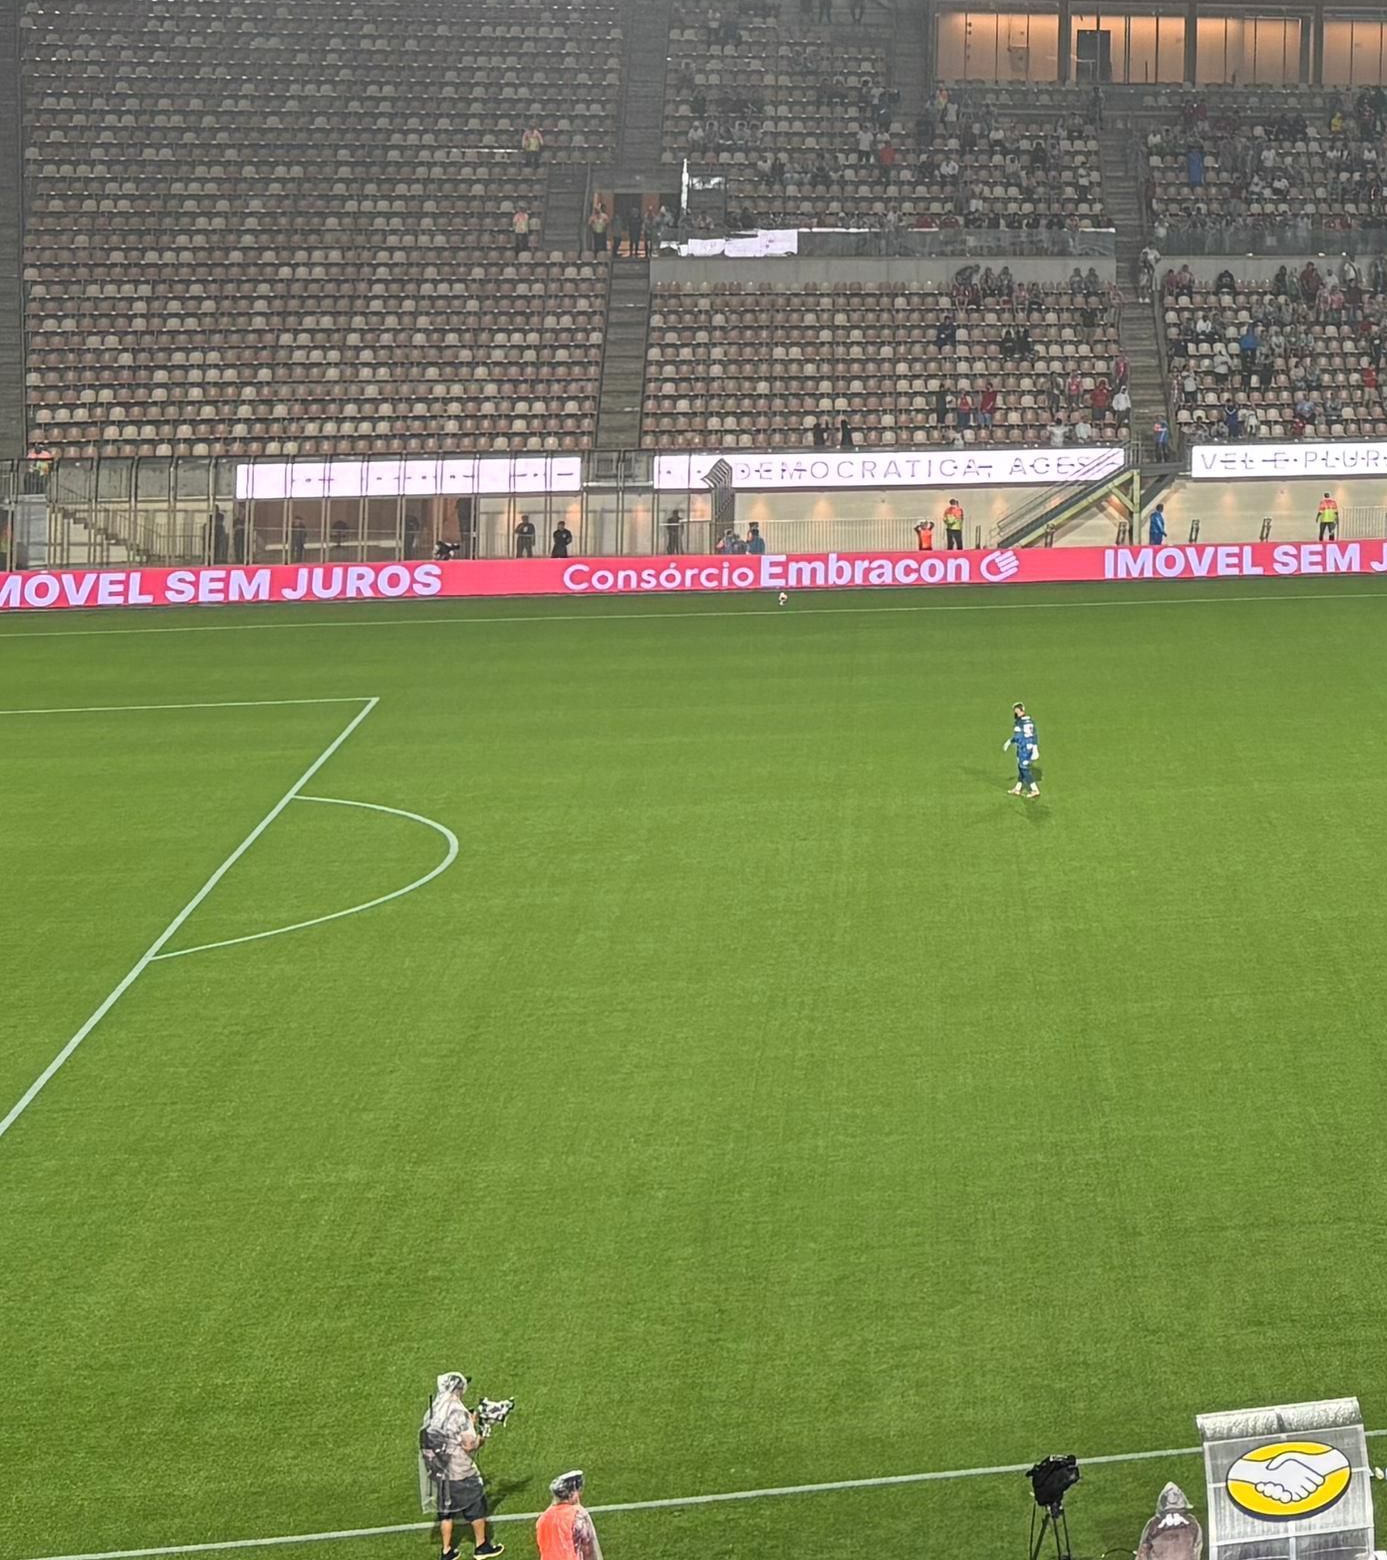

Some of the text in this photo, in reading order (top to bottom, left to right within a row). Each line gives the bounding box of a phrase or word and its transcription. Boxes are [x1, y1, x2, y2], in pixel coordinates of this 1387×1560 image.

[564, 552, 970, 591] Consórcio Embracon
[1272, 541, 1362, 575] SEM
[165, 569, 272, 604] SEM
[281, 563, 443, 601] JUROS
